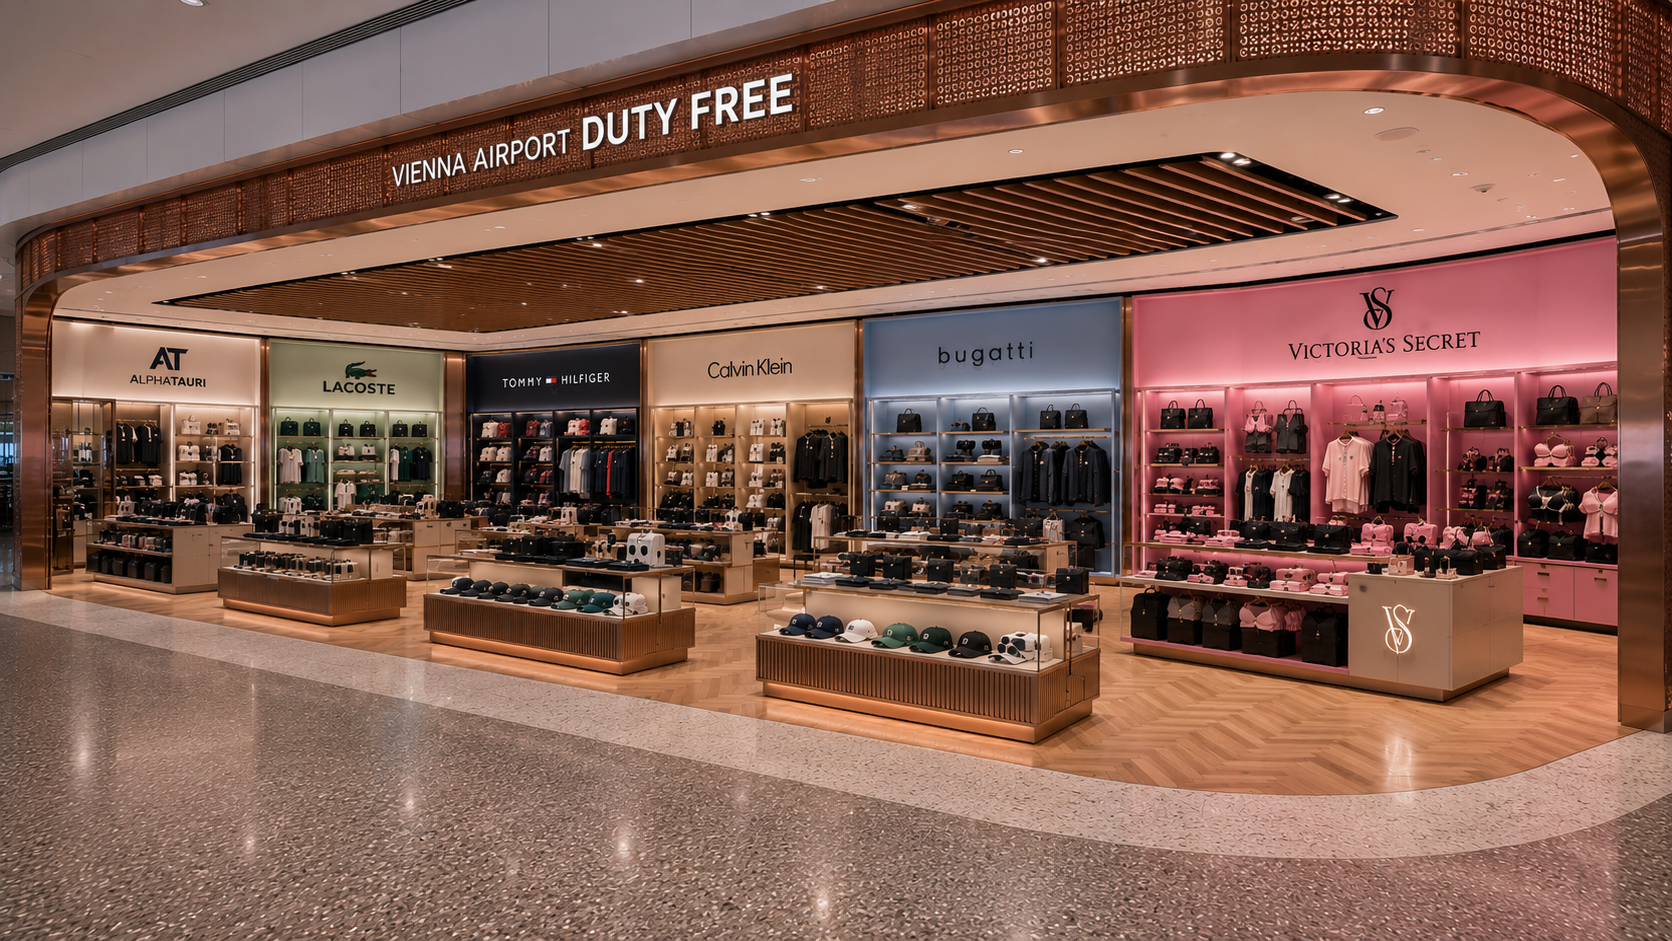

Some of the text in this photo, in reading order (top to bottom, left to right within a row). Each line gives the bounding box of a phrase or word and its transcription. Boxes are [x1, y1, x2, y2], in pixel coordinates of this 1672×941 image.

[392, 73, 794, 187] VIENNA AIRPORT DUTY FREE
[938, 341, 1033, 366] bugatti
[1288, 331, 1481, 360] VICTORIA'S SECRET
[149, 346, 189, 371] AT
[707, 357, 793, 379] Calvin Klein
[130, 374, 206, 388] ALPHATAURI
[322, 380, 396, 395] LACOSTE
[561, 372, 610, 385] HILFIGER
